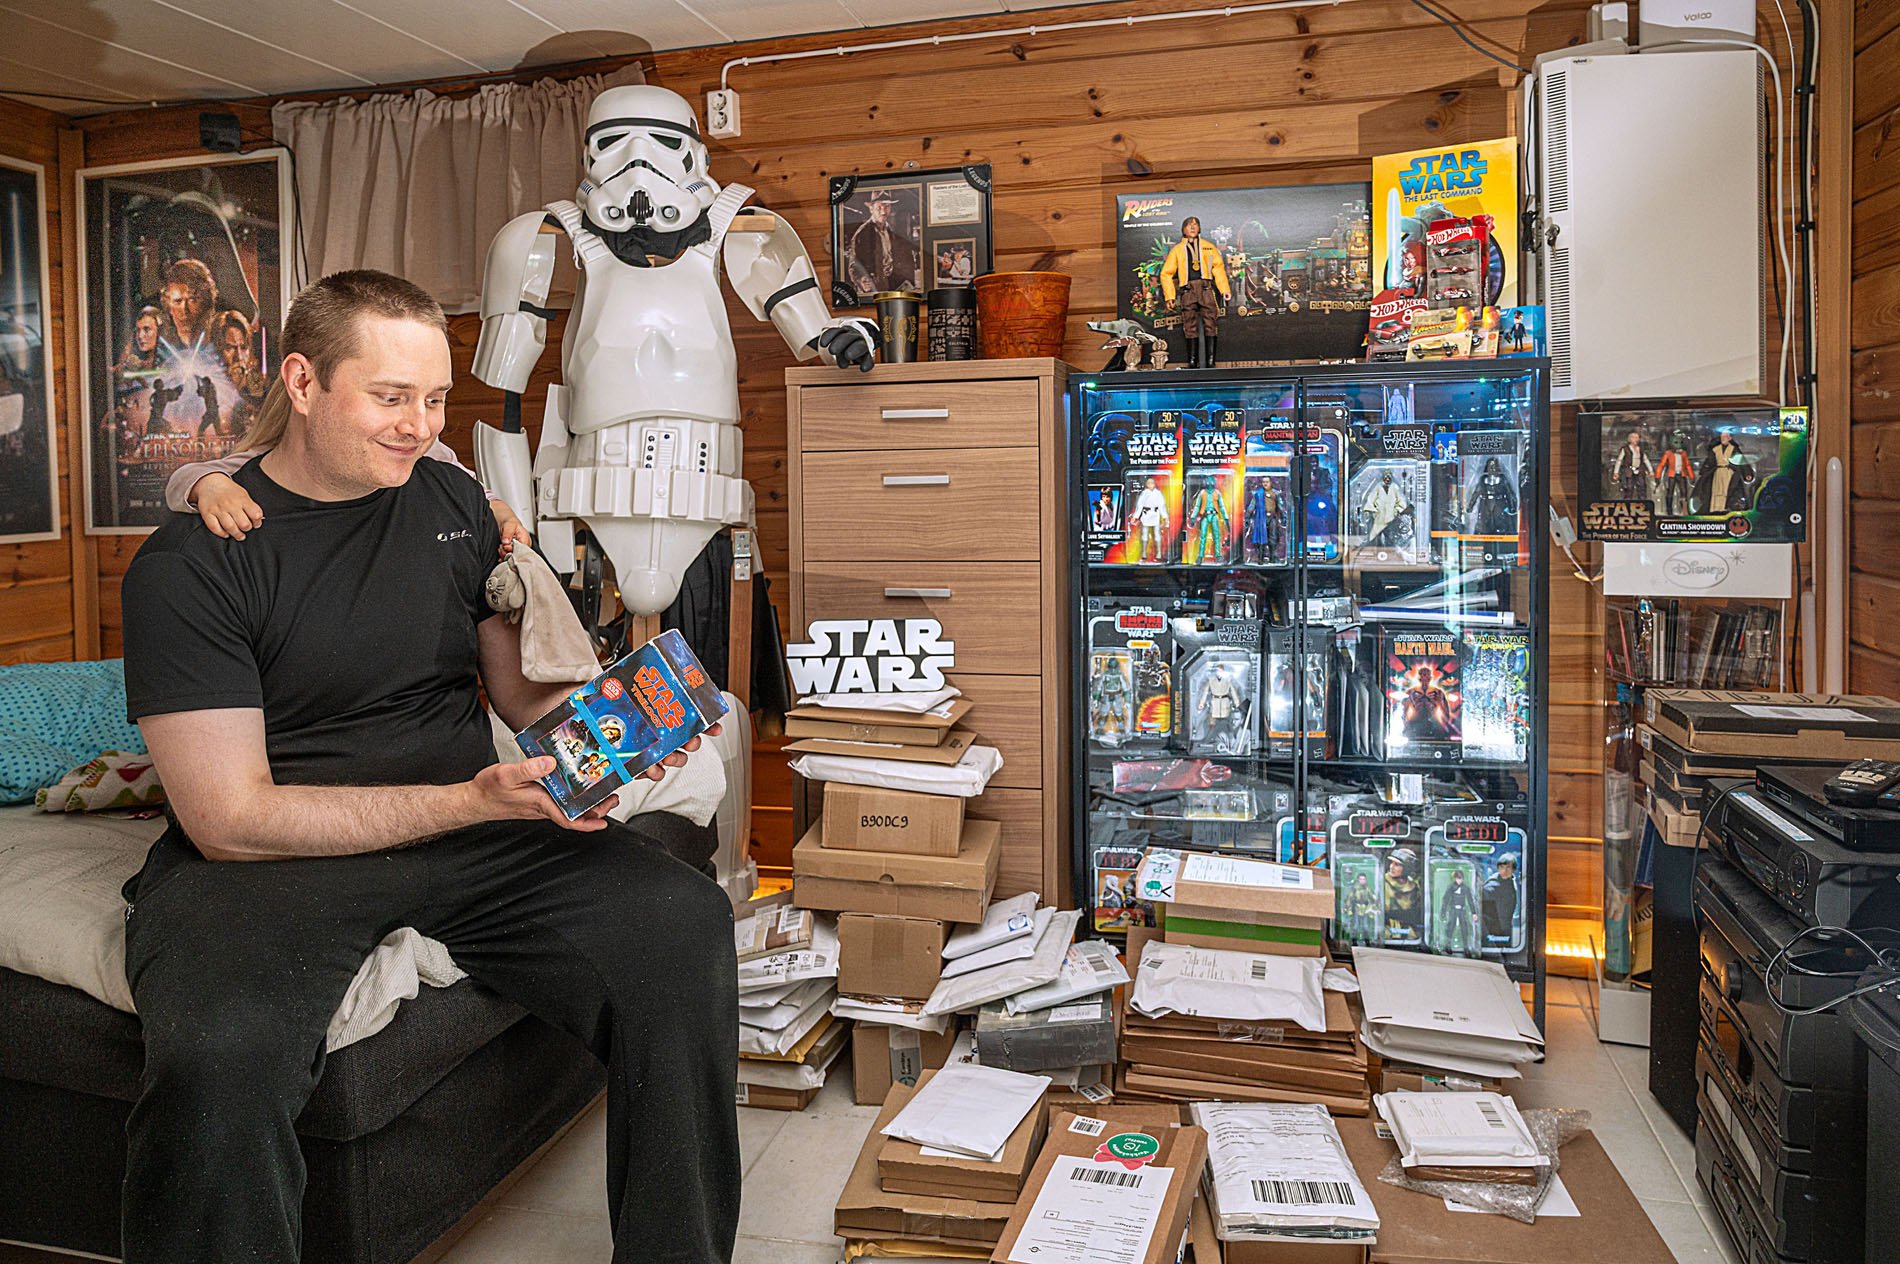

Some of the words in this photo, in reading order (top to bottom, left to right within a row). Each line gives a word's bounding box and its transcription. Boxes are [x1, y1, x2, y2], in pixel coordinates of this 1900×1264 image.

[1399, 149, 1487, 177] STAR
[1399, 168, 1487, 195] WARS
[1404, 195, 1418, 203] THE
[1420, 193, 1438, 202] LAST
[1440, 187, 1483, 199] COMMAND
[1123, 198, 1173, 221] RAIDERS
[1162, 411, 1172, 421] 50
[1225, 411, 1235, 421] 50
[1126, 432, 1178, 445] STAR
[1188, 431, 1240, 444] STAR
[1383, 430, 1427, 440] STAR
[1470, 434, 1503, 442] STAR
[1126, 444, 1178, 456] WARS
[1188, 443, 1240, 456] WARS
[1383, 439, 1427, 450] WARS
[1470, 442, 1503, 450] WARS
[1416, 463, 1427, 504] ARCHIVE
[1582, 503, 1650, 516] STAR
[1582, 515, 1650, 530] WARS
[1660, 523, 1687, 531] CANTINA
[1688, 523, 1726, 531] SHOWDOWN
[1668, 559, 1725, 581] Disney
[1130, 606, 1152, 614] STAR
[1128, 629, 1155, 638] WARS
[1218, 624, 1259, 634] STAR
[786, 619, 955, 657] STAR
[1218, 633, 1259, 643] WARS
[1500, 635, 1529, 643] WAR
[1394, 642, 1426, 656] DARTH
[786, 656, 955, 695] WARS
[633, 665, 684, 729] WARS
[649, 666, 687, 722] STAR
[631, 684, 664, 729] TRILOGY
[1453, 825, 1499, 840] JEDI
